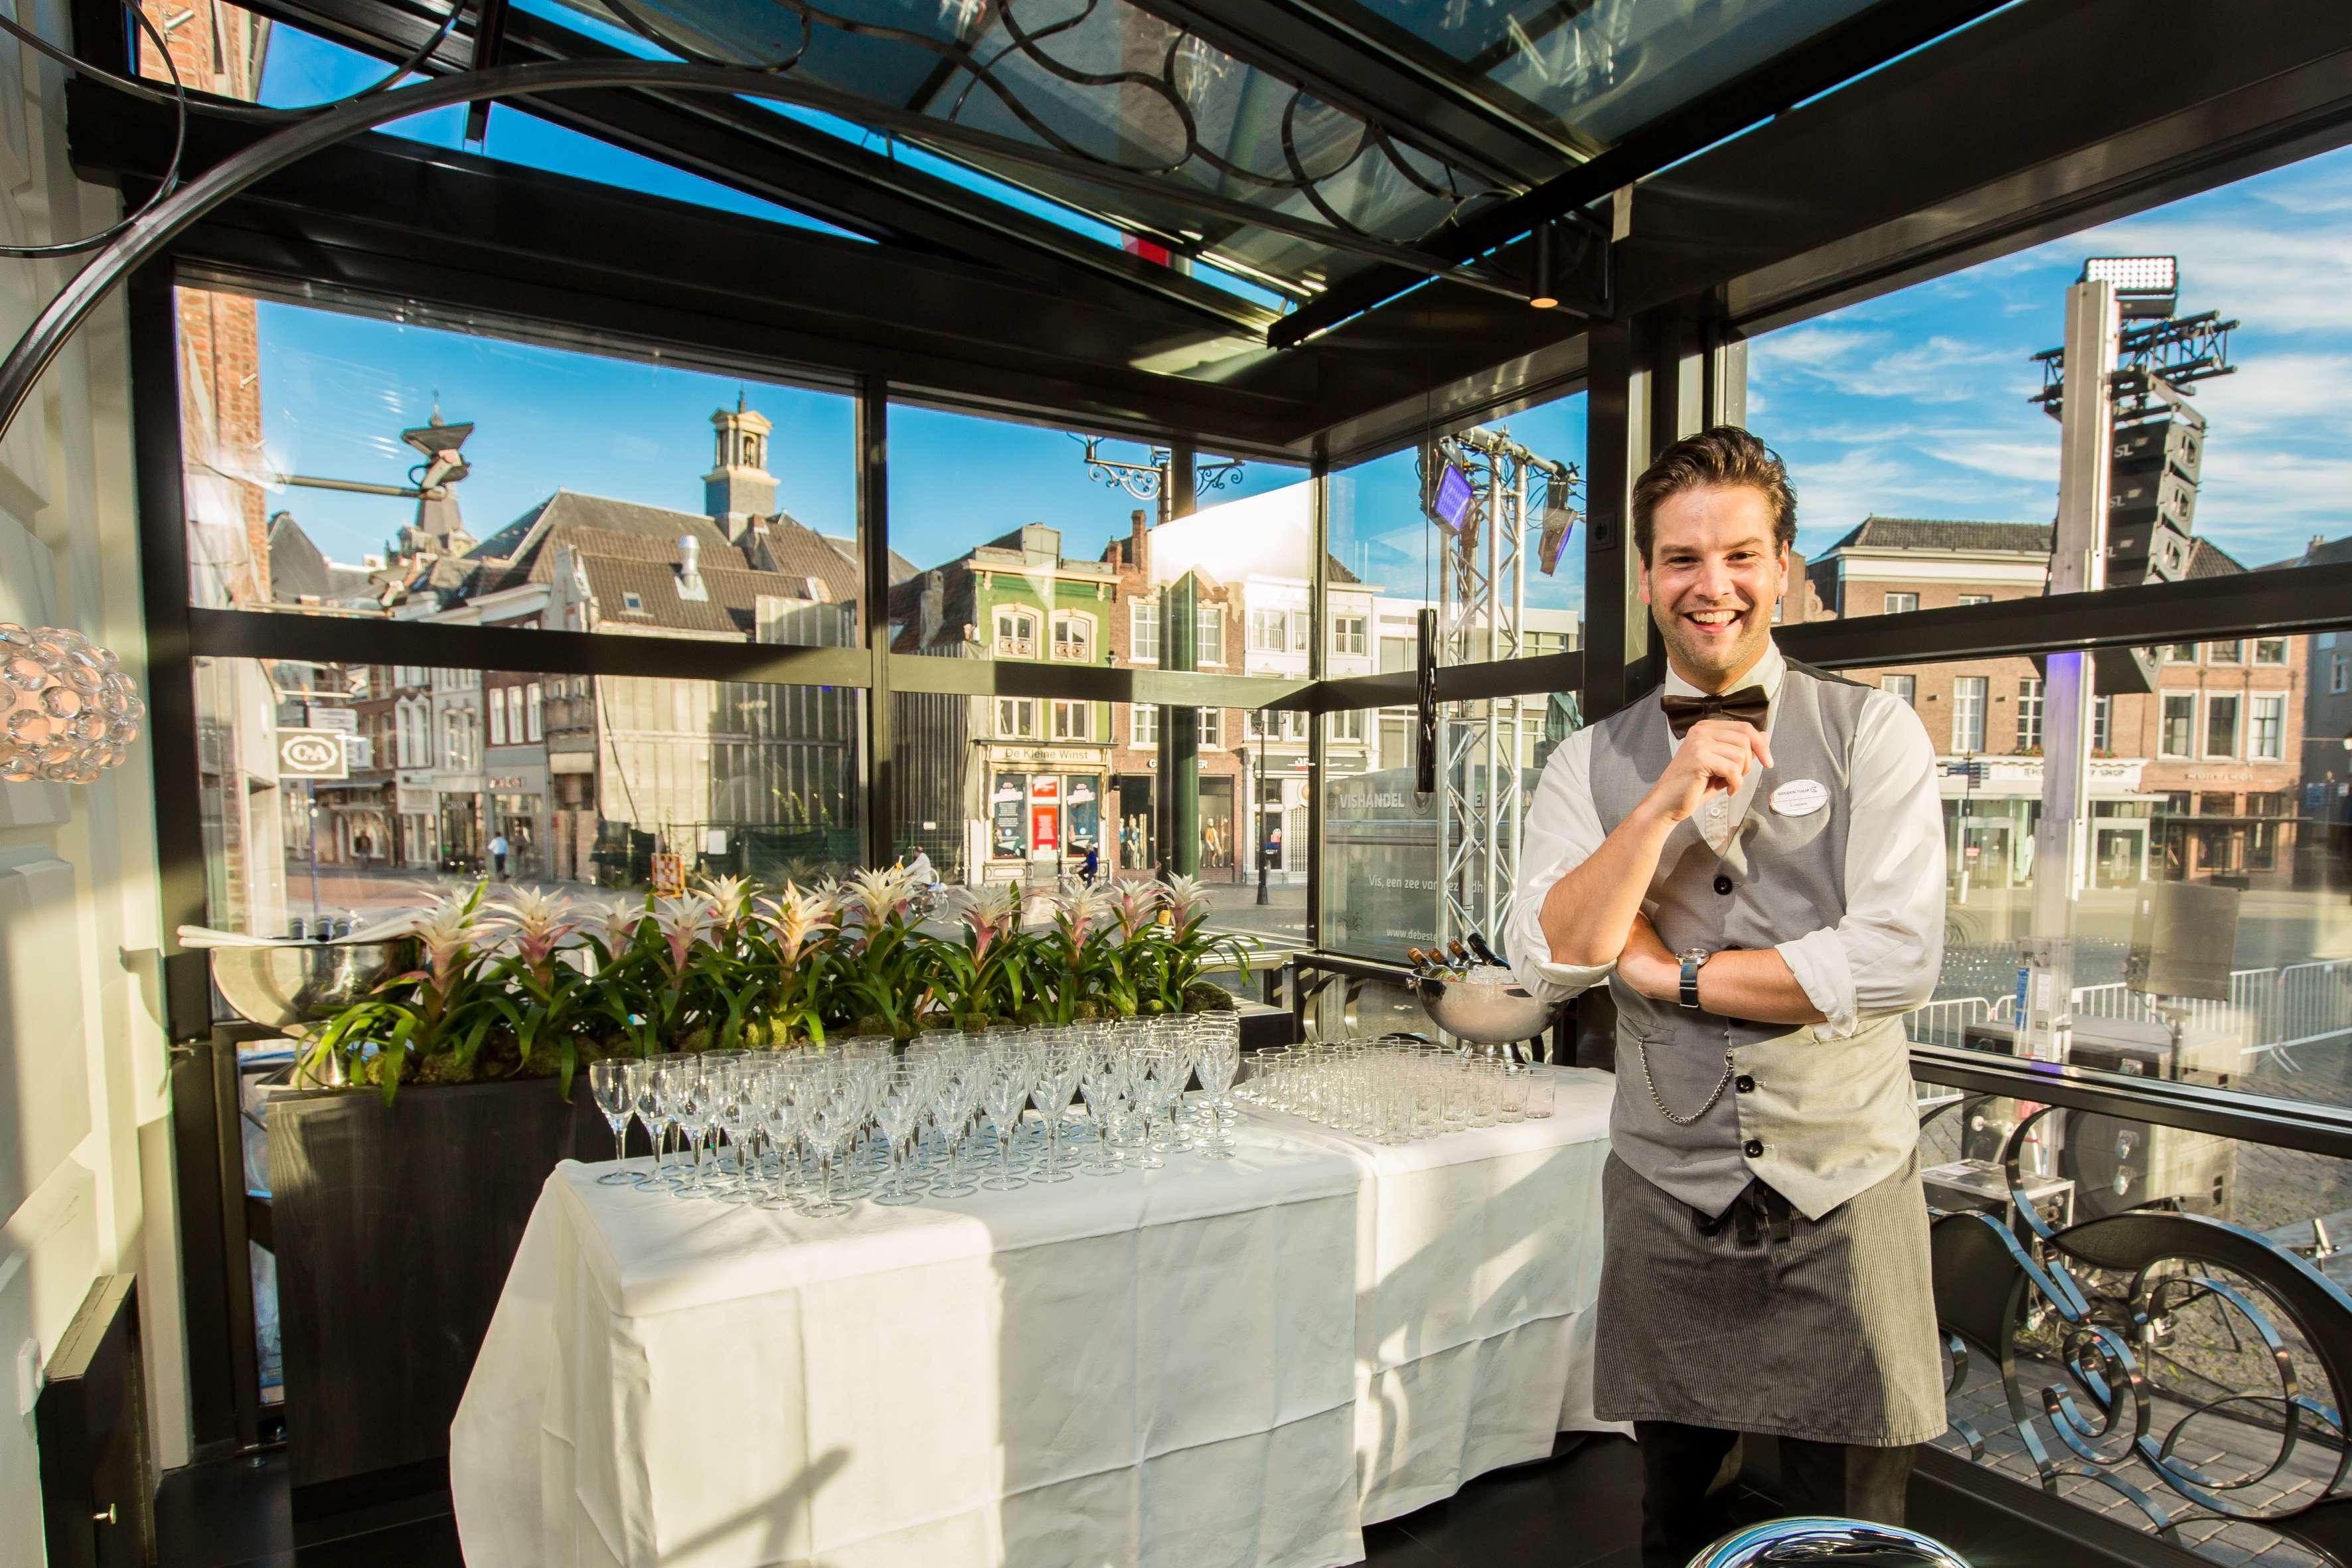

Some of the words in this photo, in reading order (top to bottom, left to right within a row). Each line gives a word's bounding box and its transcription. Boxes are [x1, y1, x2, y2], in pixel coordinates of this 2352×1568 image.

[291, 744, 330, 762] C&A
[1005, 748, 1020, 758] De
[1024, 748, 1056, 759] Kleine
[1059, 749, 1089, 759] Winst
[1340, 792, 1405, 809] VISHANDEL
[1368, 874, 1384, 888] Vis,
[1386, 878, 1402, 888] een
[1405, 880, 1420, 890] zee
